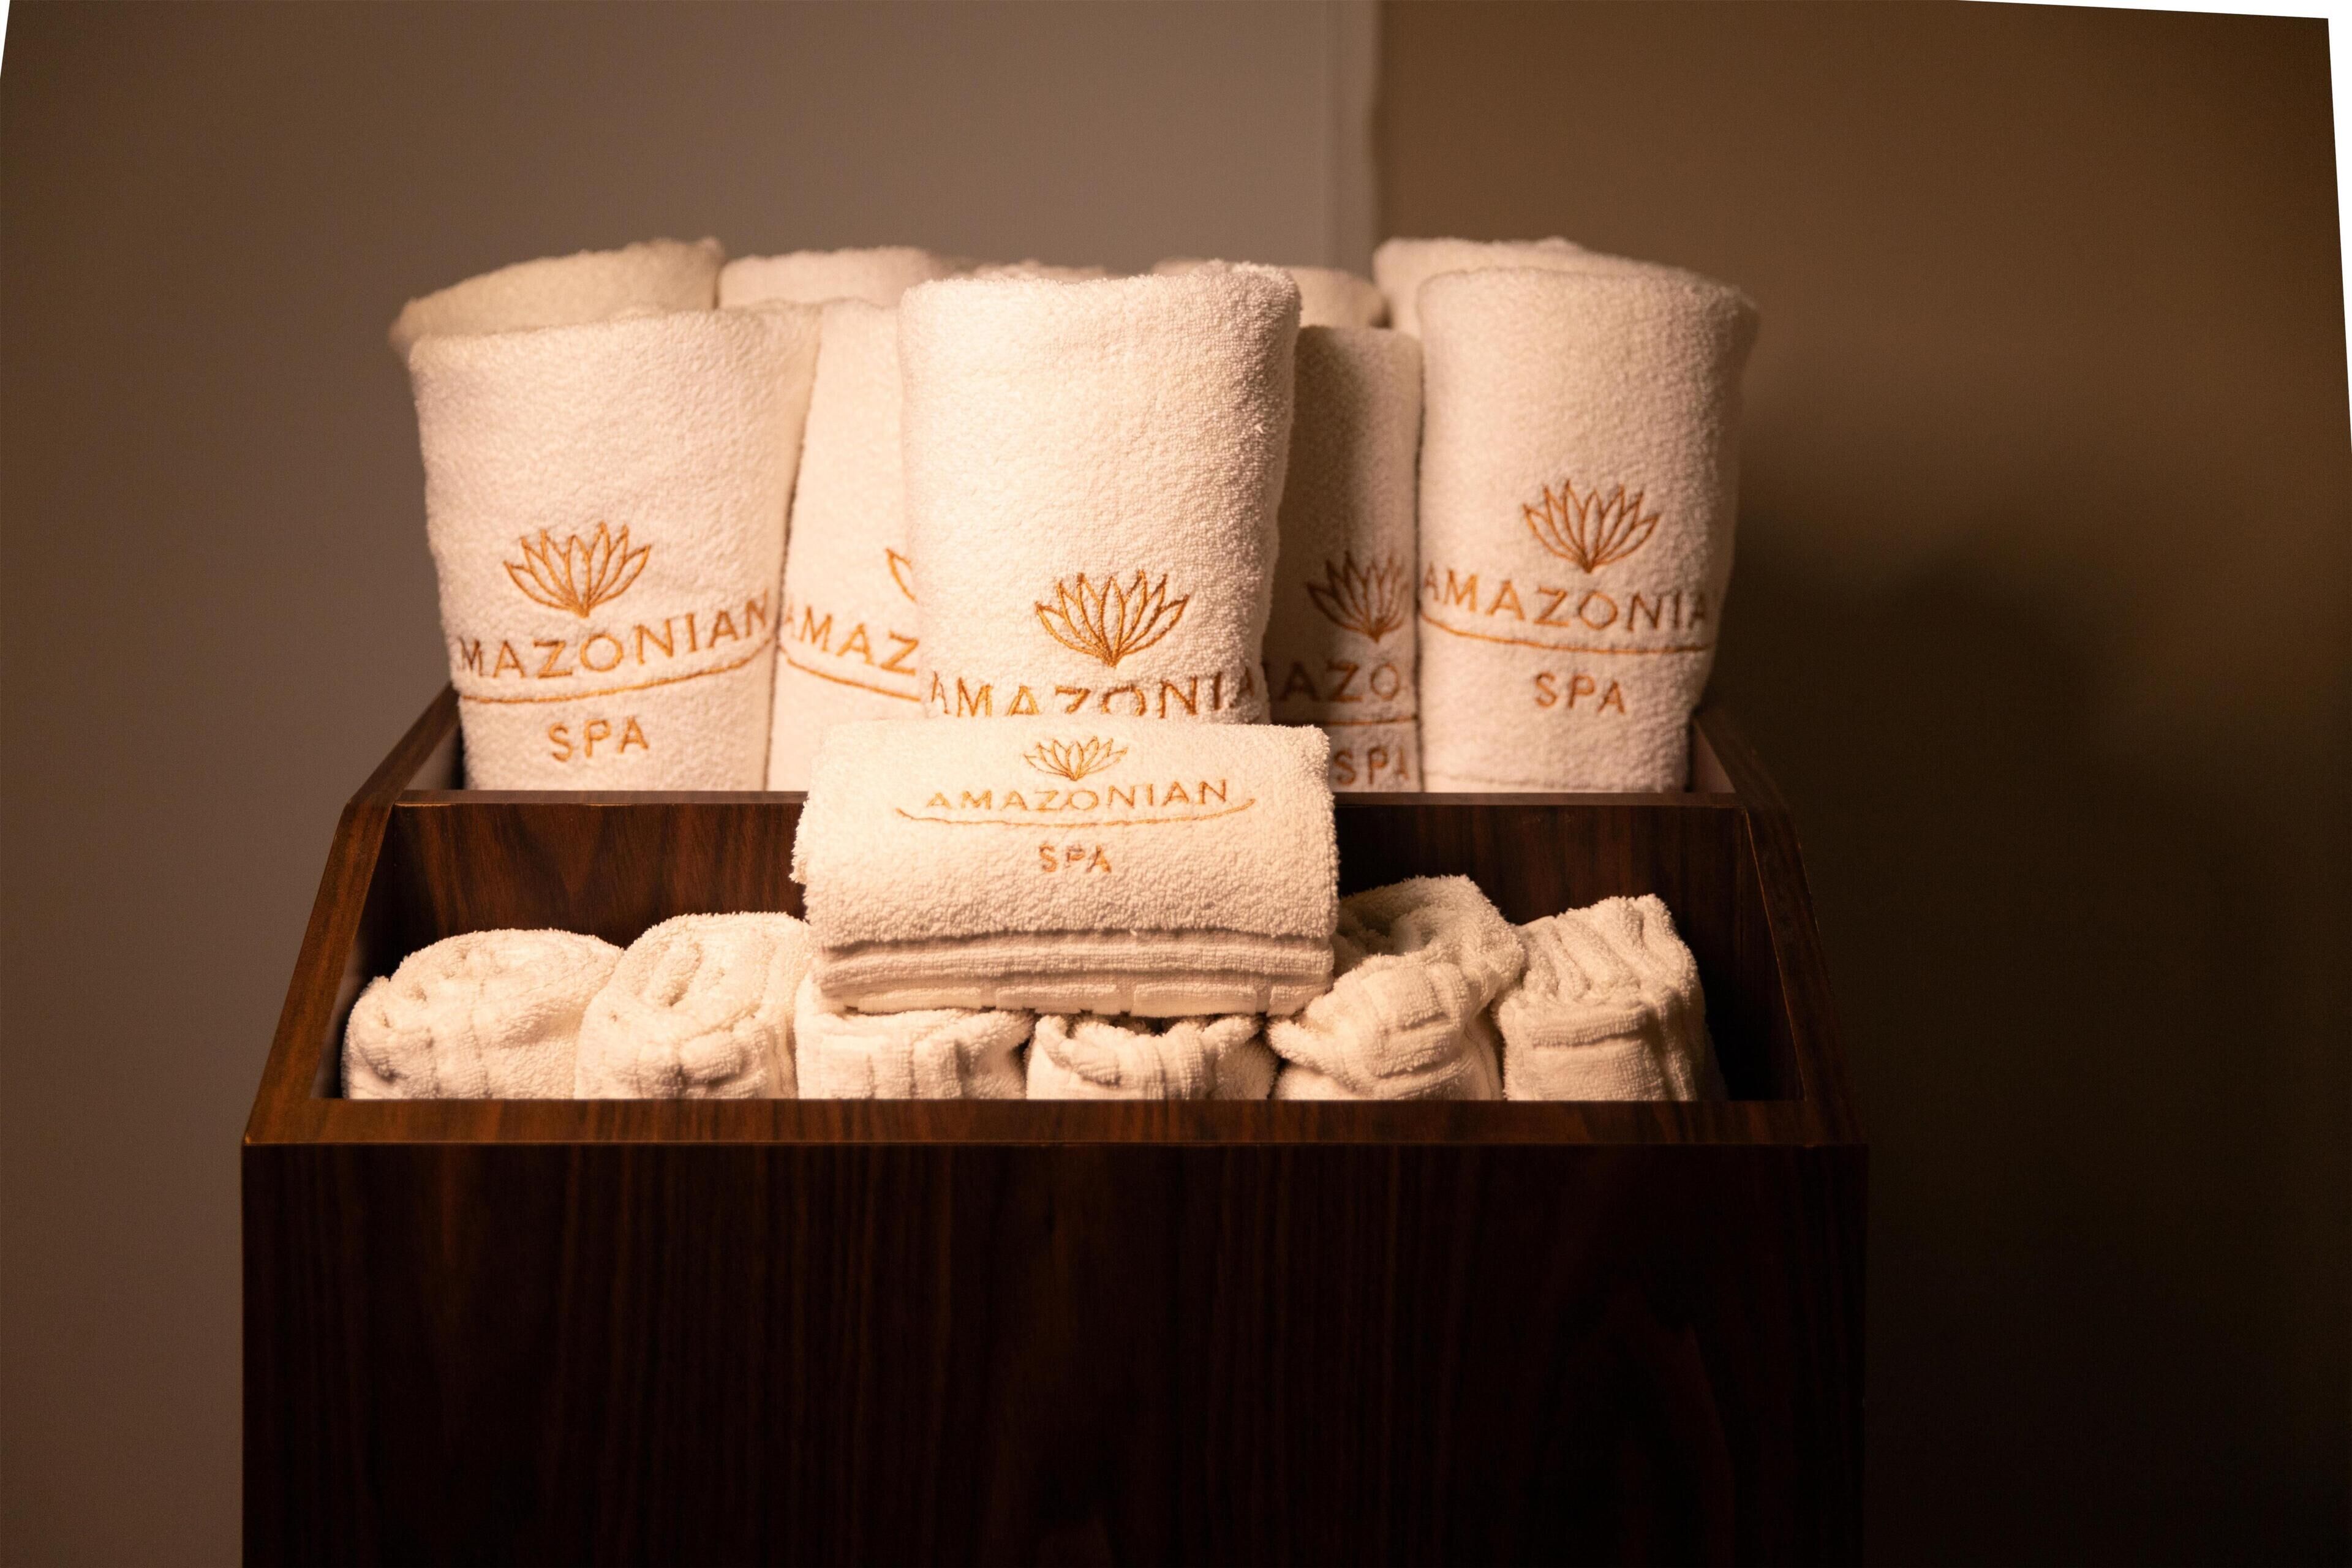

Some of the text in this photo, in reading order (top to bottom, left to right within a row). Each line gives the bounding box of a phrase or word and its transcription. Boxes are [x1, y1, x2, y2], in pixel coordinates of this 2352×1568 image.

[1262, 659, 1400, 702] AZO
[1535, 672, 1626, 715] SPA
[549, 715, 648, 761] SPA
[927, 778, 1226, 812] AMAZONIAN
[1039, 842, 1112, 873] SPA
